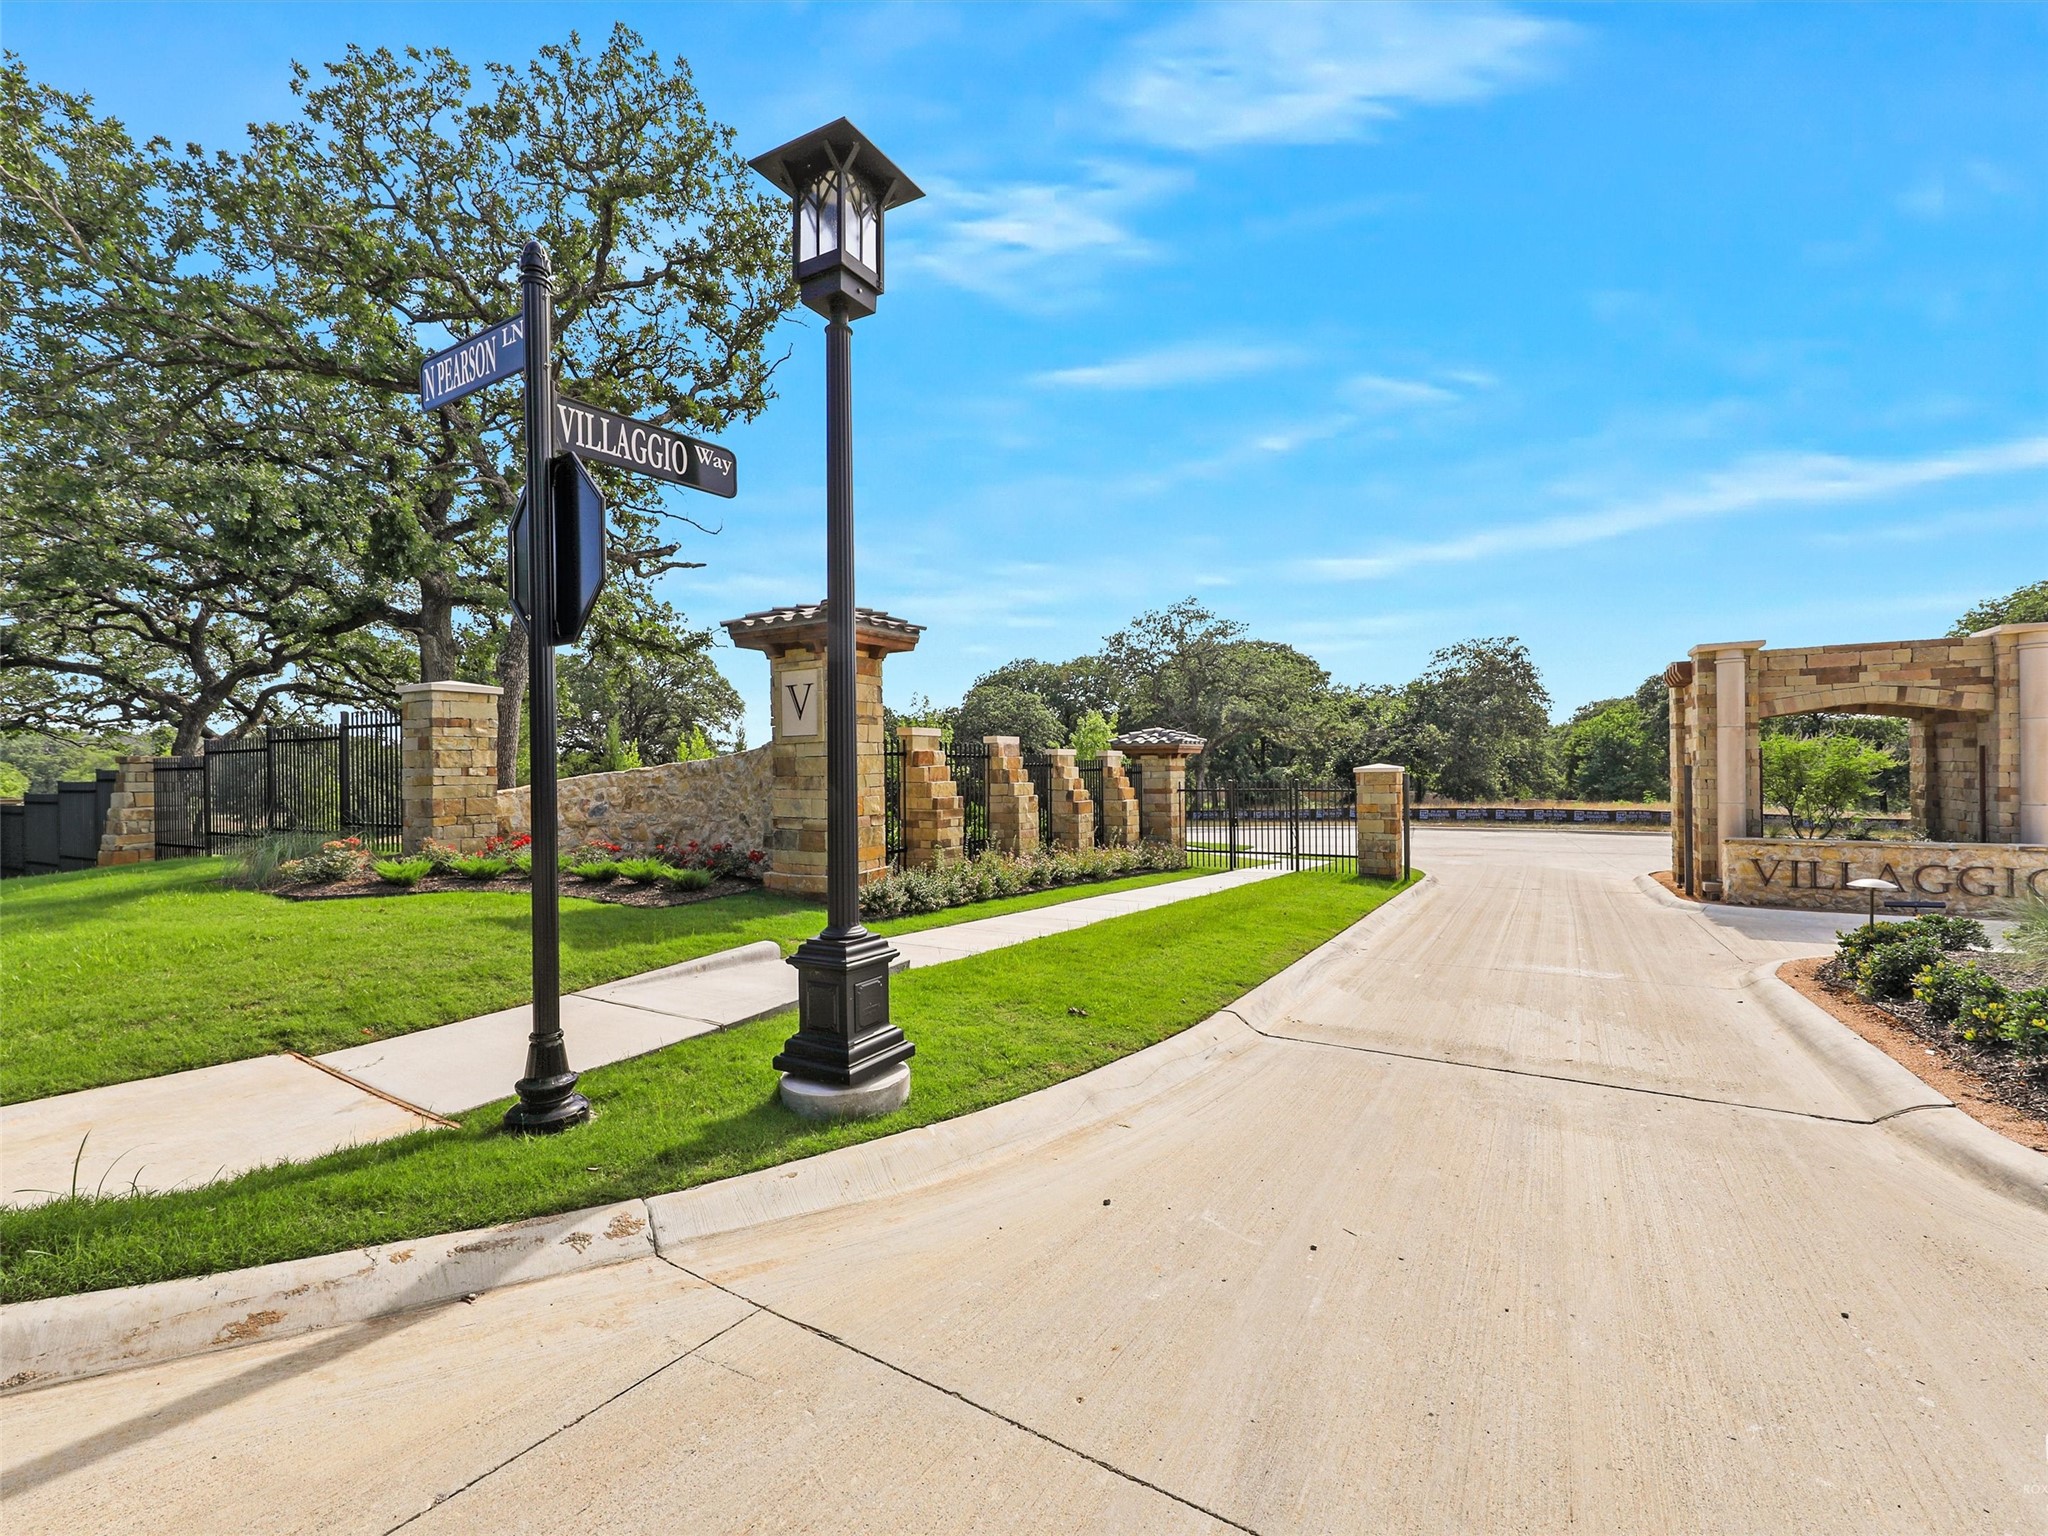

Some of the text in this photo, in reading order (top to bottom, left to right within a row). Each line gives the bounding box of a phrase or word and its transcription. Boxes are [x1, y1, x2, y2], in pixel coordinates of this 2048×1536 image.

[423, 319, 524, 402] N PEARSON LN
[556, 403, 733, 476] VILLAGGIO Way
[785, 682, 814, 721] V
